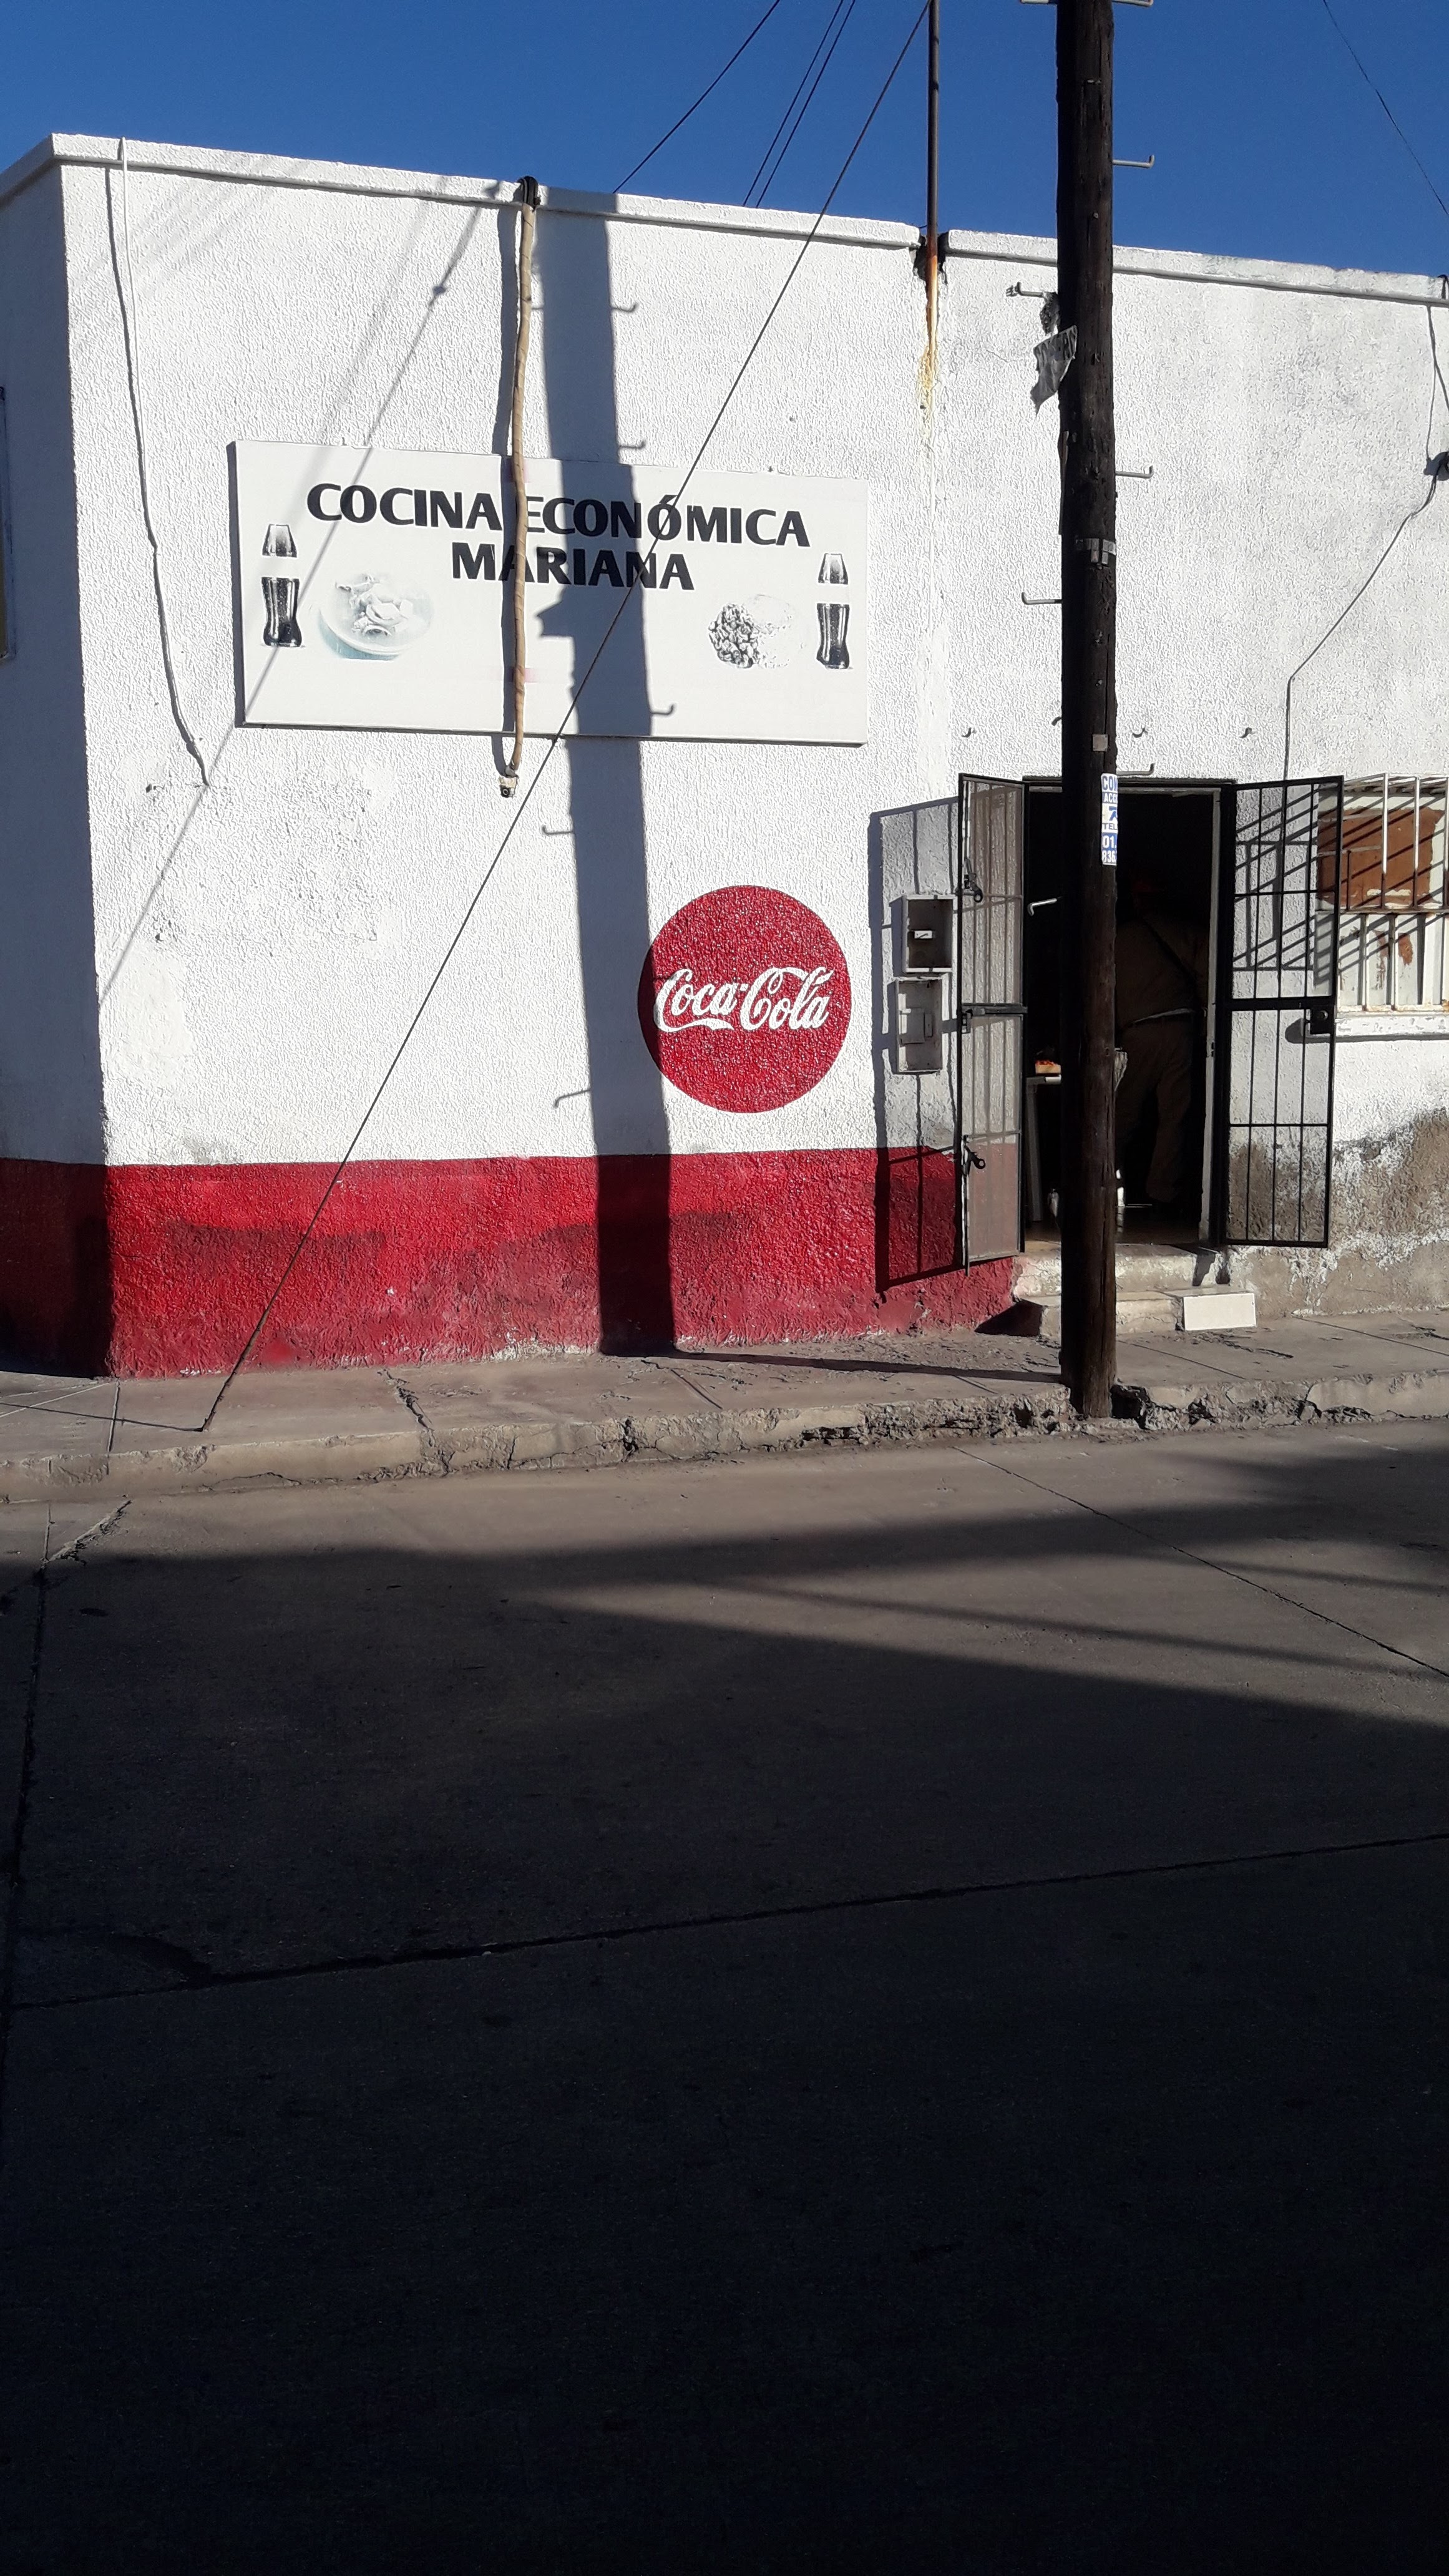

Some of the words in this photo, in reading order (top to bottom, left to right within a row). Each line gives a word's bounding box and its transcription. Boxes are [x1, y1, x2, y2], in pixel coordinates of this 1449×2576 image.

[306, 483, 502, 530] COCINA
[515, 495, 810, 547] ECONÓMICA
[452, 542, 695, 590] MARIANA
[1102, 822, 1117, 831] TEL
[653, 967, 834, 1032] Coca-Cola
